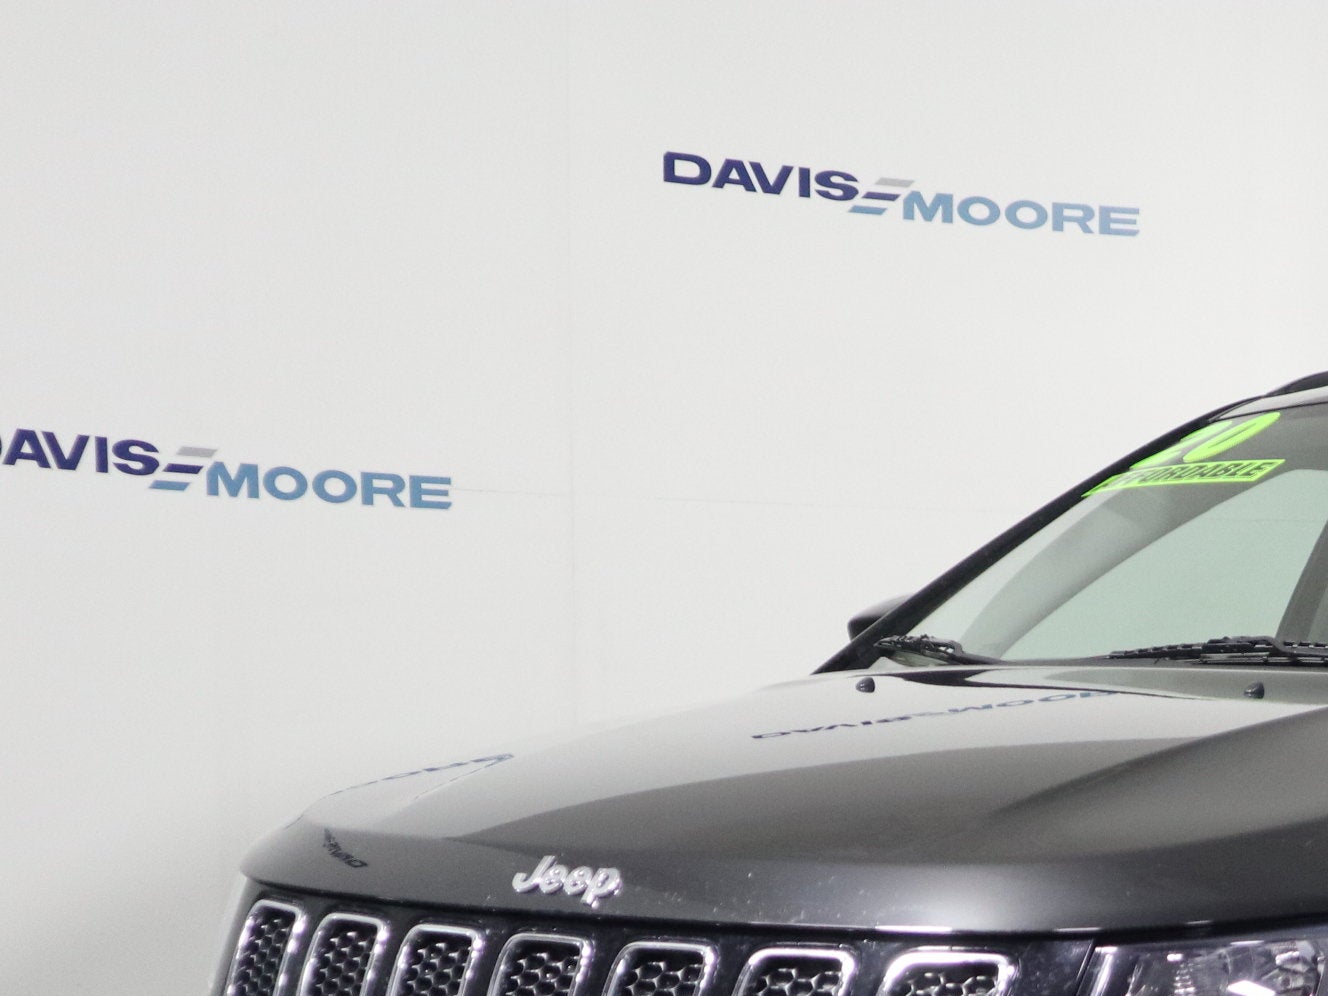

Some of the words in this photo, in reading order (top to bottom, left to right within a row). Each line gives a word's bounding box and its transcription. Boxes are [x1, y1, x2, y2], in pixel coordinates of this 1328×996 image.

[663, 151, 859, 201] DAVIS
[902, 191, 1140, 237] MOORE
[0, 428, 160, 476] AVIS
[206, 461, 452, 510] MOORE
[512, 855, 622, 909] Jeep
